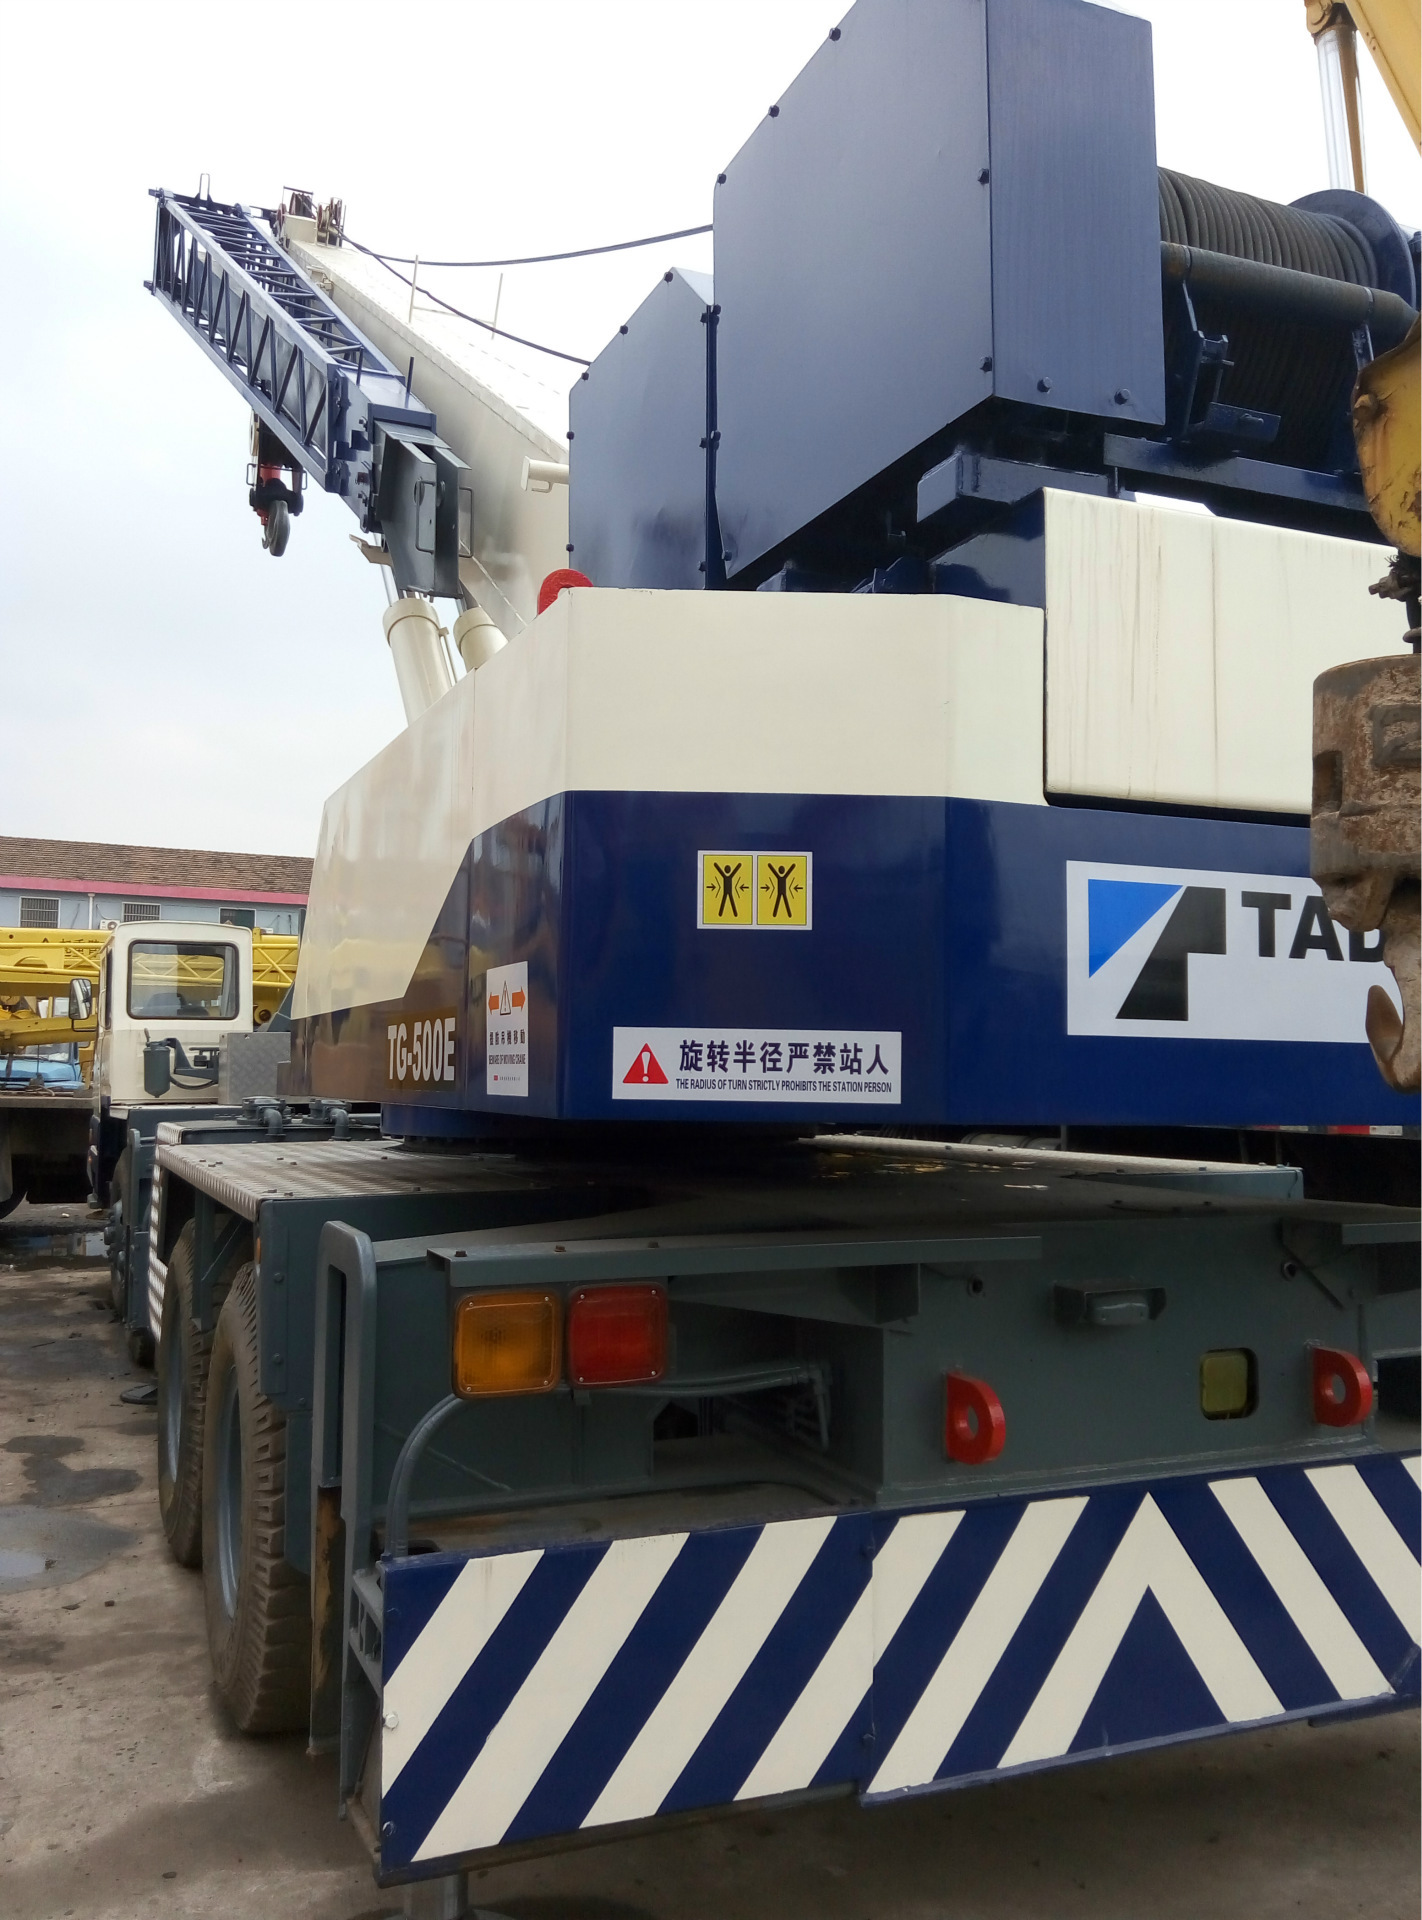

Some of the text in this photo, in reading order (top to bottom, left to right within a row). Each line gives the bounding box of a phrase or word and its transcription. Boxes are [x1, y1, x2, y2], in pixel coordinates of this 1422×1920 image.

[679, 1039, 889, 1075] 旋转半径严禁站人
[676, 1078, 892, 1093] THE RADIUS OF TURN STRICTLY PROHIBITS THE STATION PERSON
